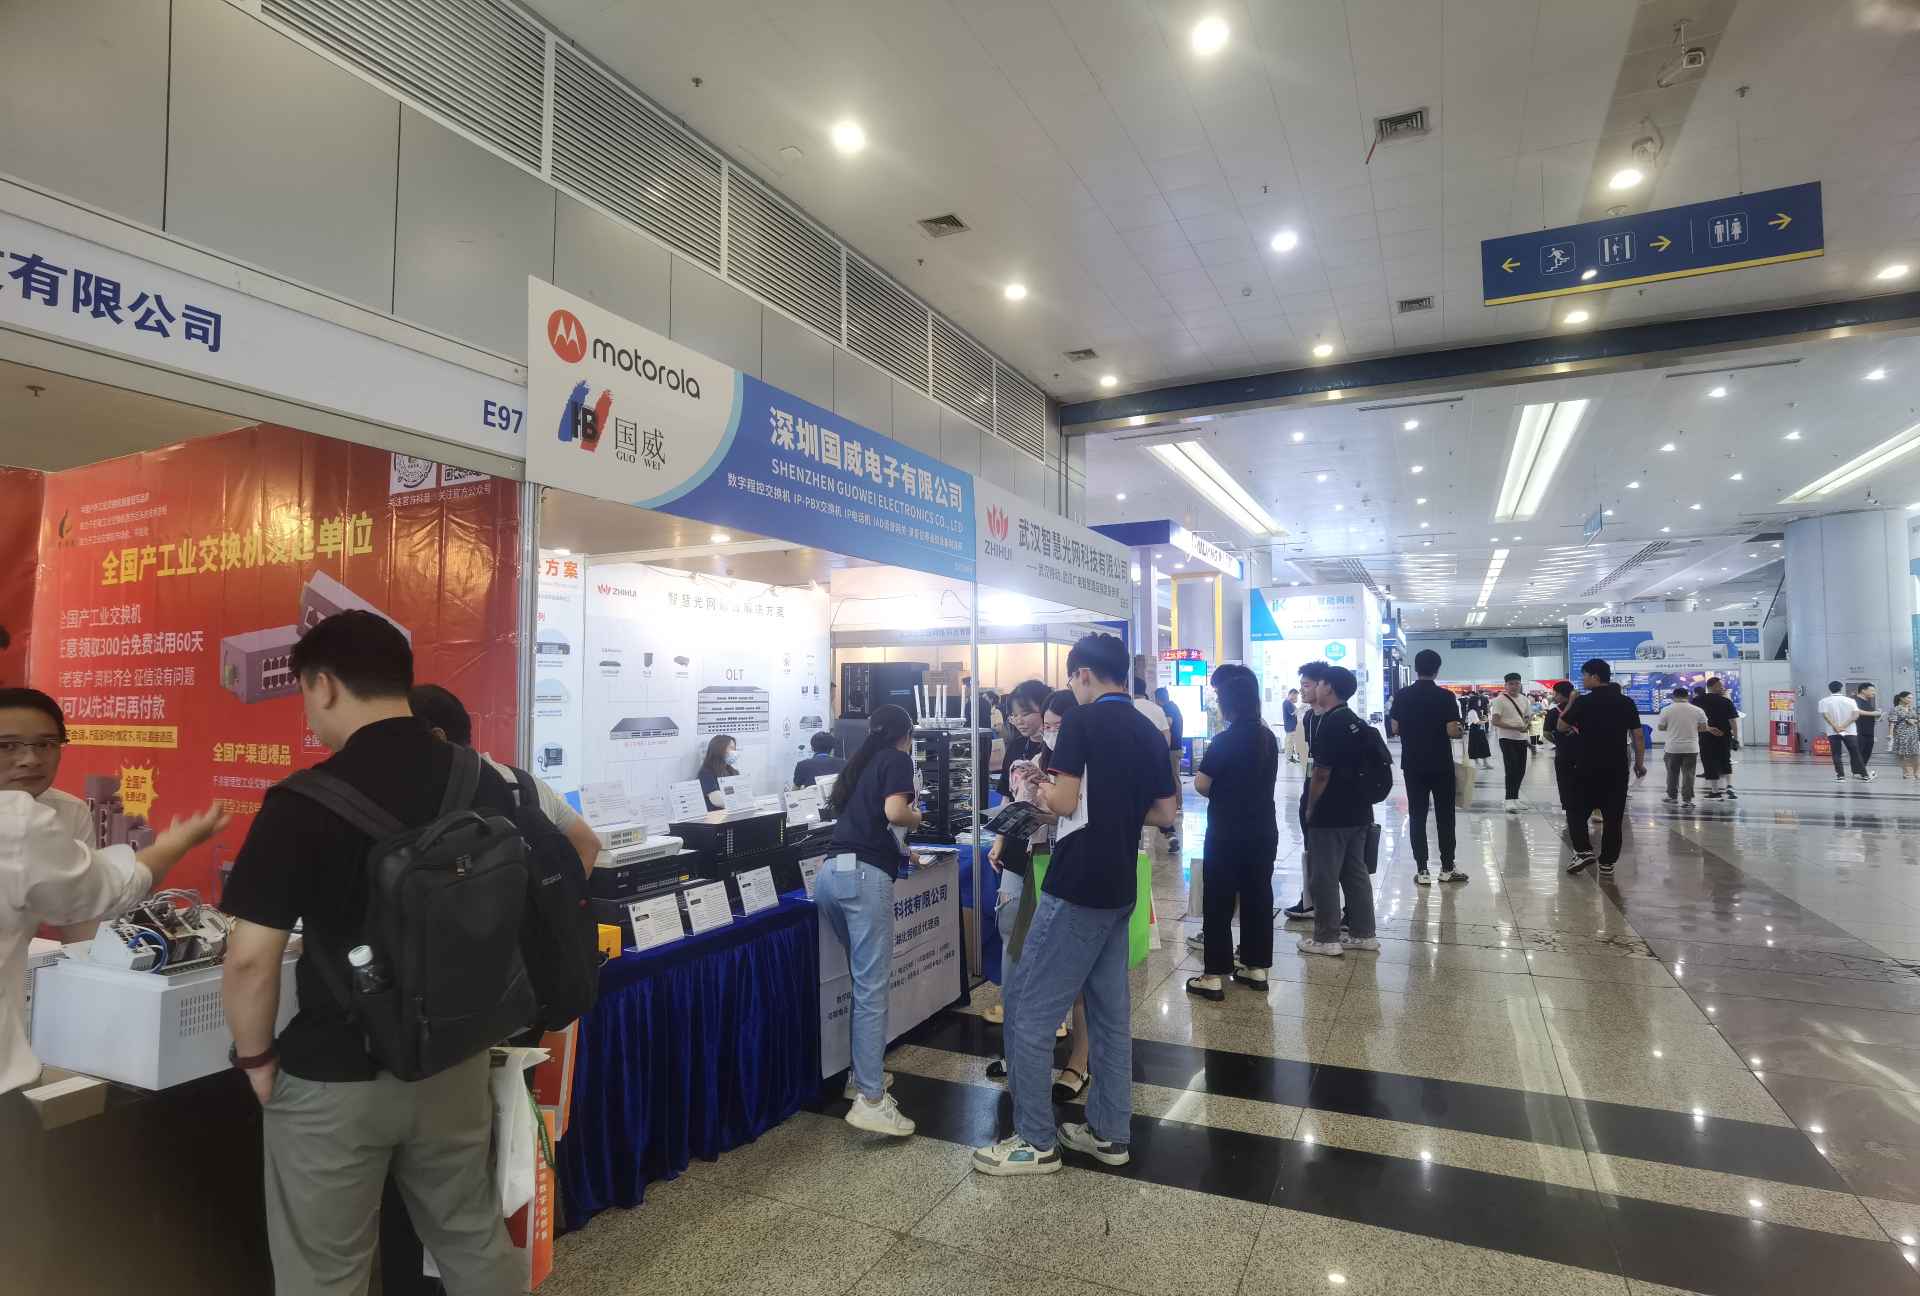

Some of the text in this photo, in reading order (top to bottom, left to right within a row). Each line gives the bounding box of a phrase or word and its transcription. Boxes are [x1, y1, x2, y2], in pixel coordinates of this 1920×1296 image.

[0, 251, 222, 352] 有限公司
[592, 338, 701, 400] motorola
[483, 400, 523, 434] E97
[614, 416, 665, 465] 国威
[616, 451, 662, 471] GUO WEI
[768, 405, 963, 514] 深圳国威电子有限公司
[727, 471, 790, 504] 数字程控交换机
[771, 458, 835, 492] SHENZHEN
[837, 481, 877, 505] GUOWEI
[878, 493, 934, 524] ELECTRONICS
[101, 510, 374, 586] 全国产工业交换机发起单位
[984, 539, 1012, 561] ZHIHUI
[1018, 517, 1128, 585] 武汉智慧光网科技有限公司
[537, 559, 578, 579] 方案
[726, 668, 745, 681] OLT
[59, 694, 166, 720] 可以先试用再付款
[213, 742, 291, 766] 全国产渠道爆品
[894, 884, 948, 921] 科技有限公司
